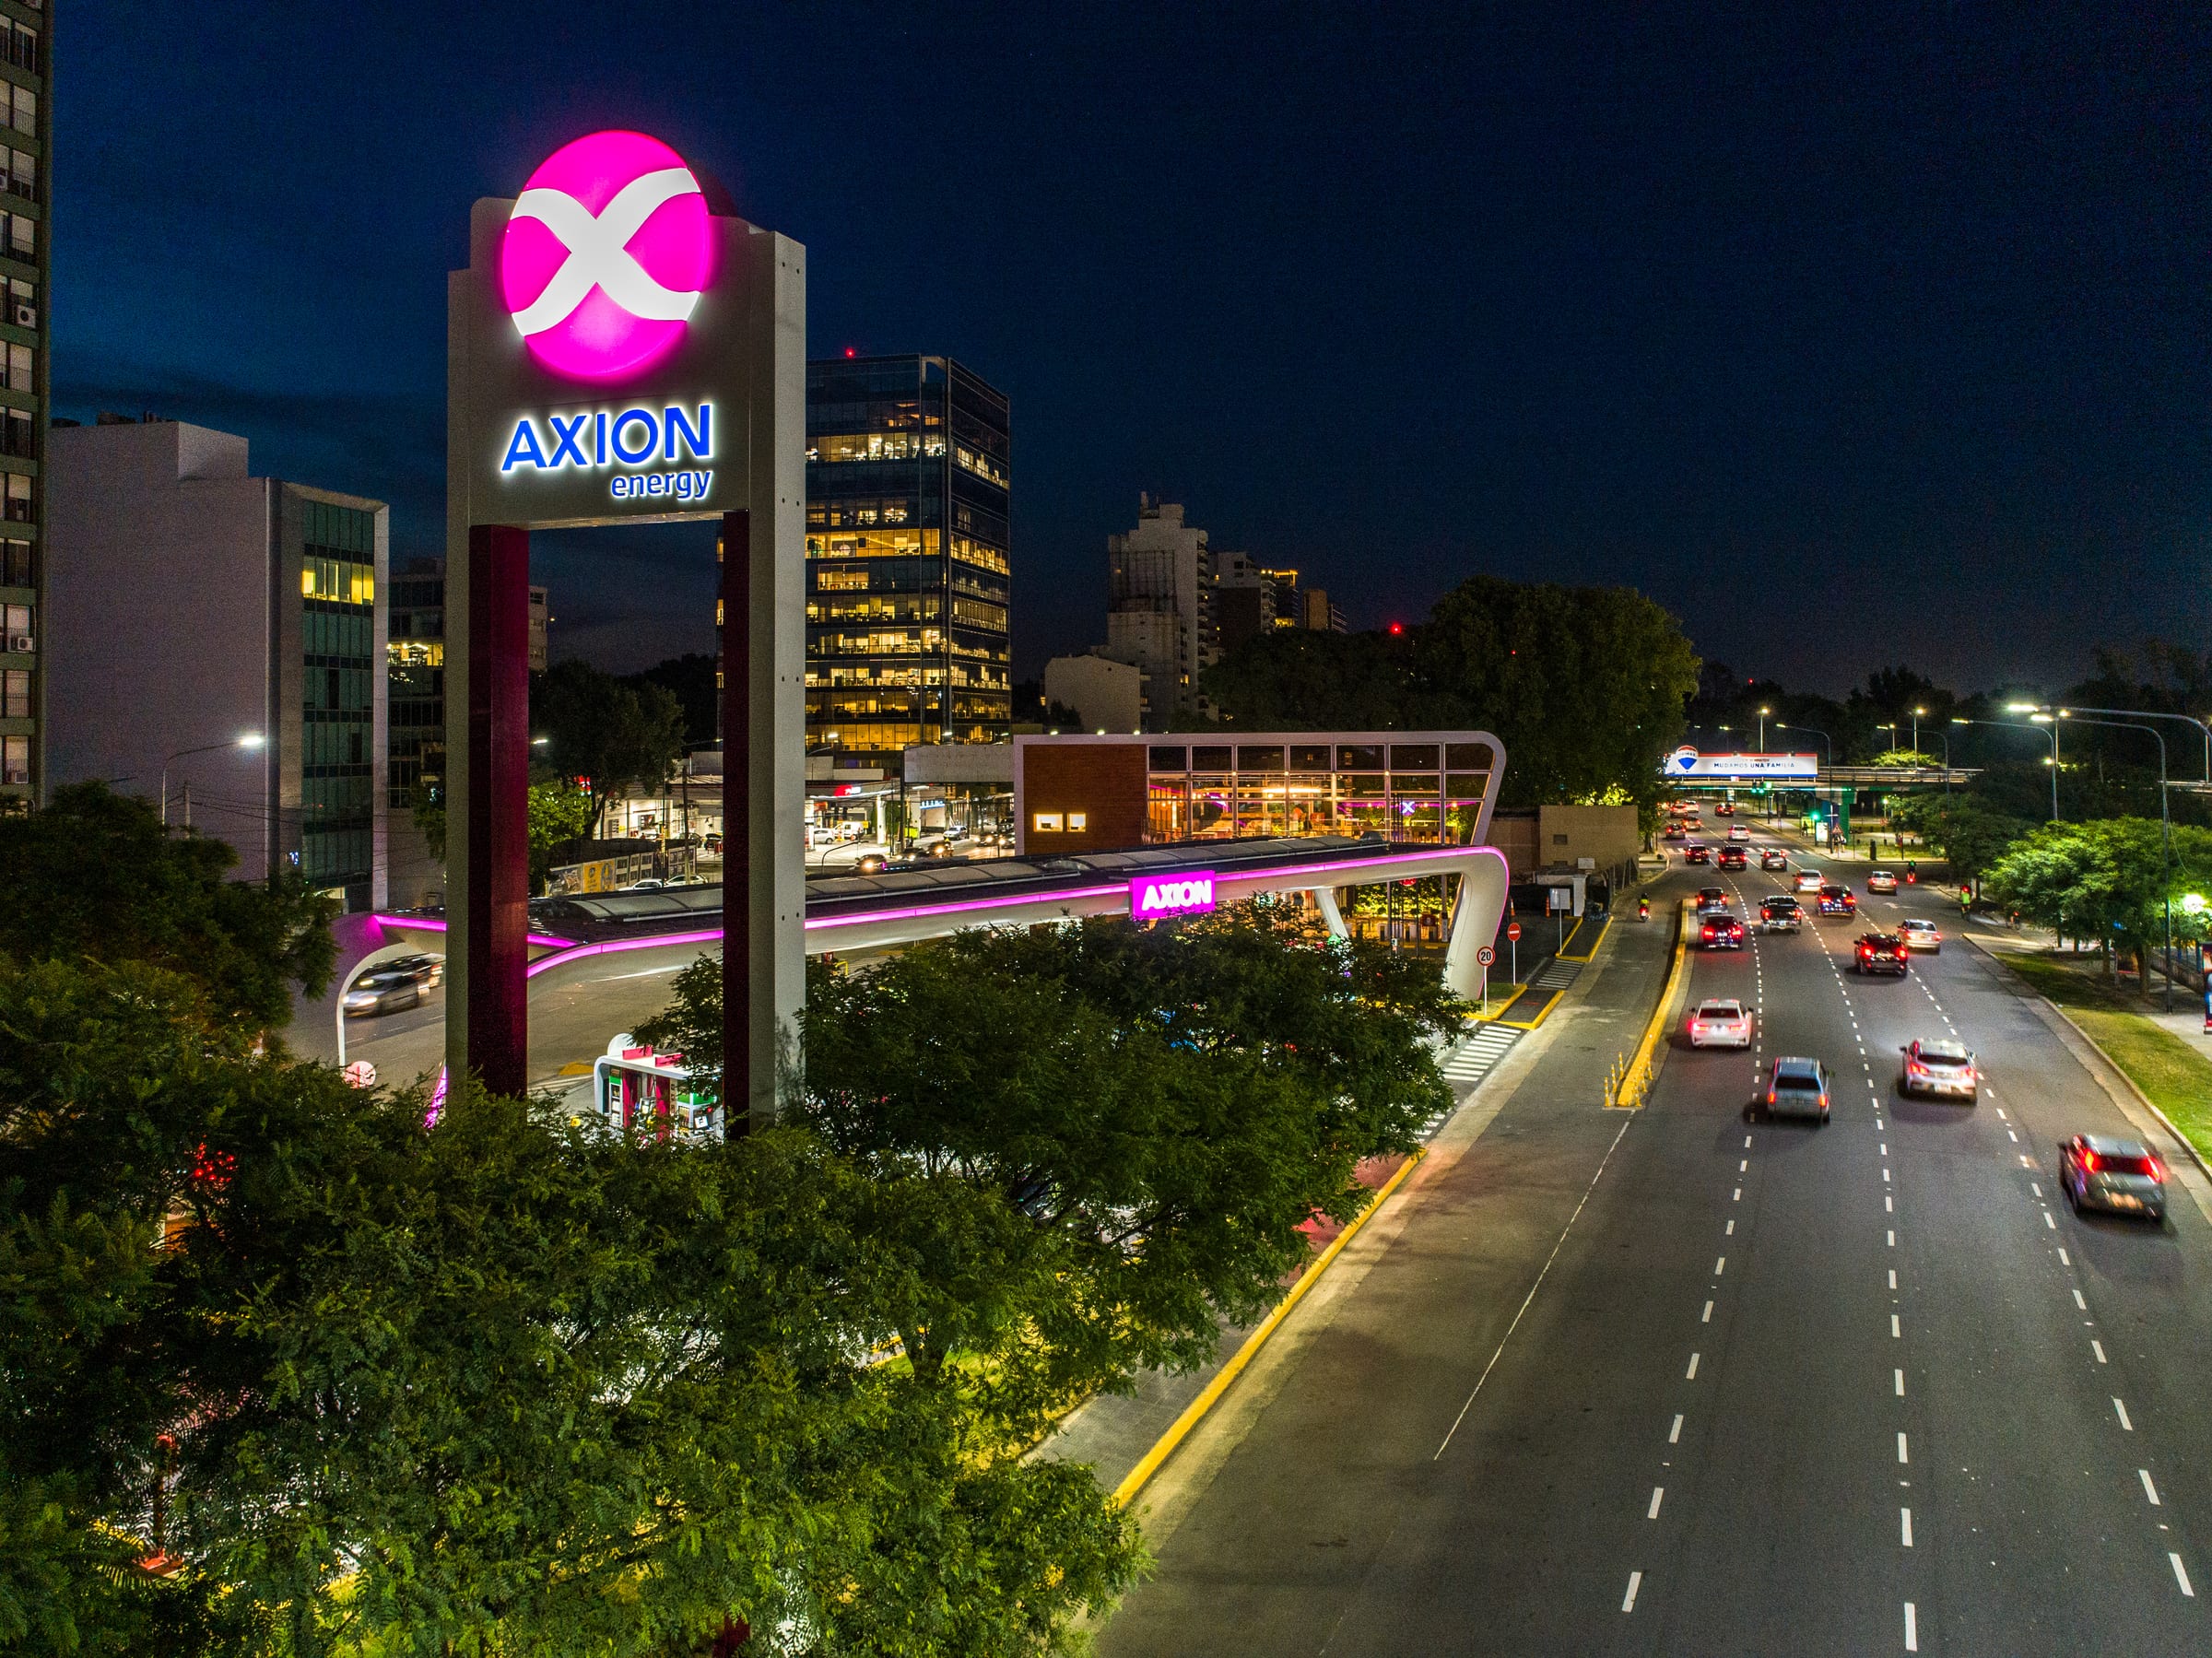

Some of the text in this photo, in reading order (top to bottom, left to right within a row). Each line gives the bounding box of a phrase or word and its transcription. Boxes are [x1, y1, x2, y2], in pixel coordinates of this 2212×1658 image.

[500, 403, 713, 473] AXION
[611, 470, 712, 500] energy
[1141, 879, 1212, 911] AXION
[1480, 951, 1491, 961] 20
